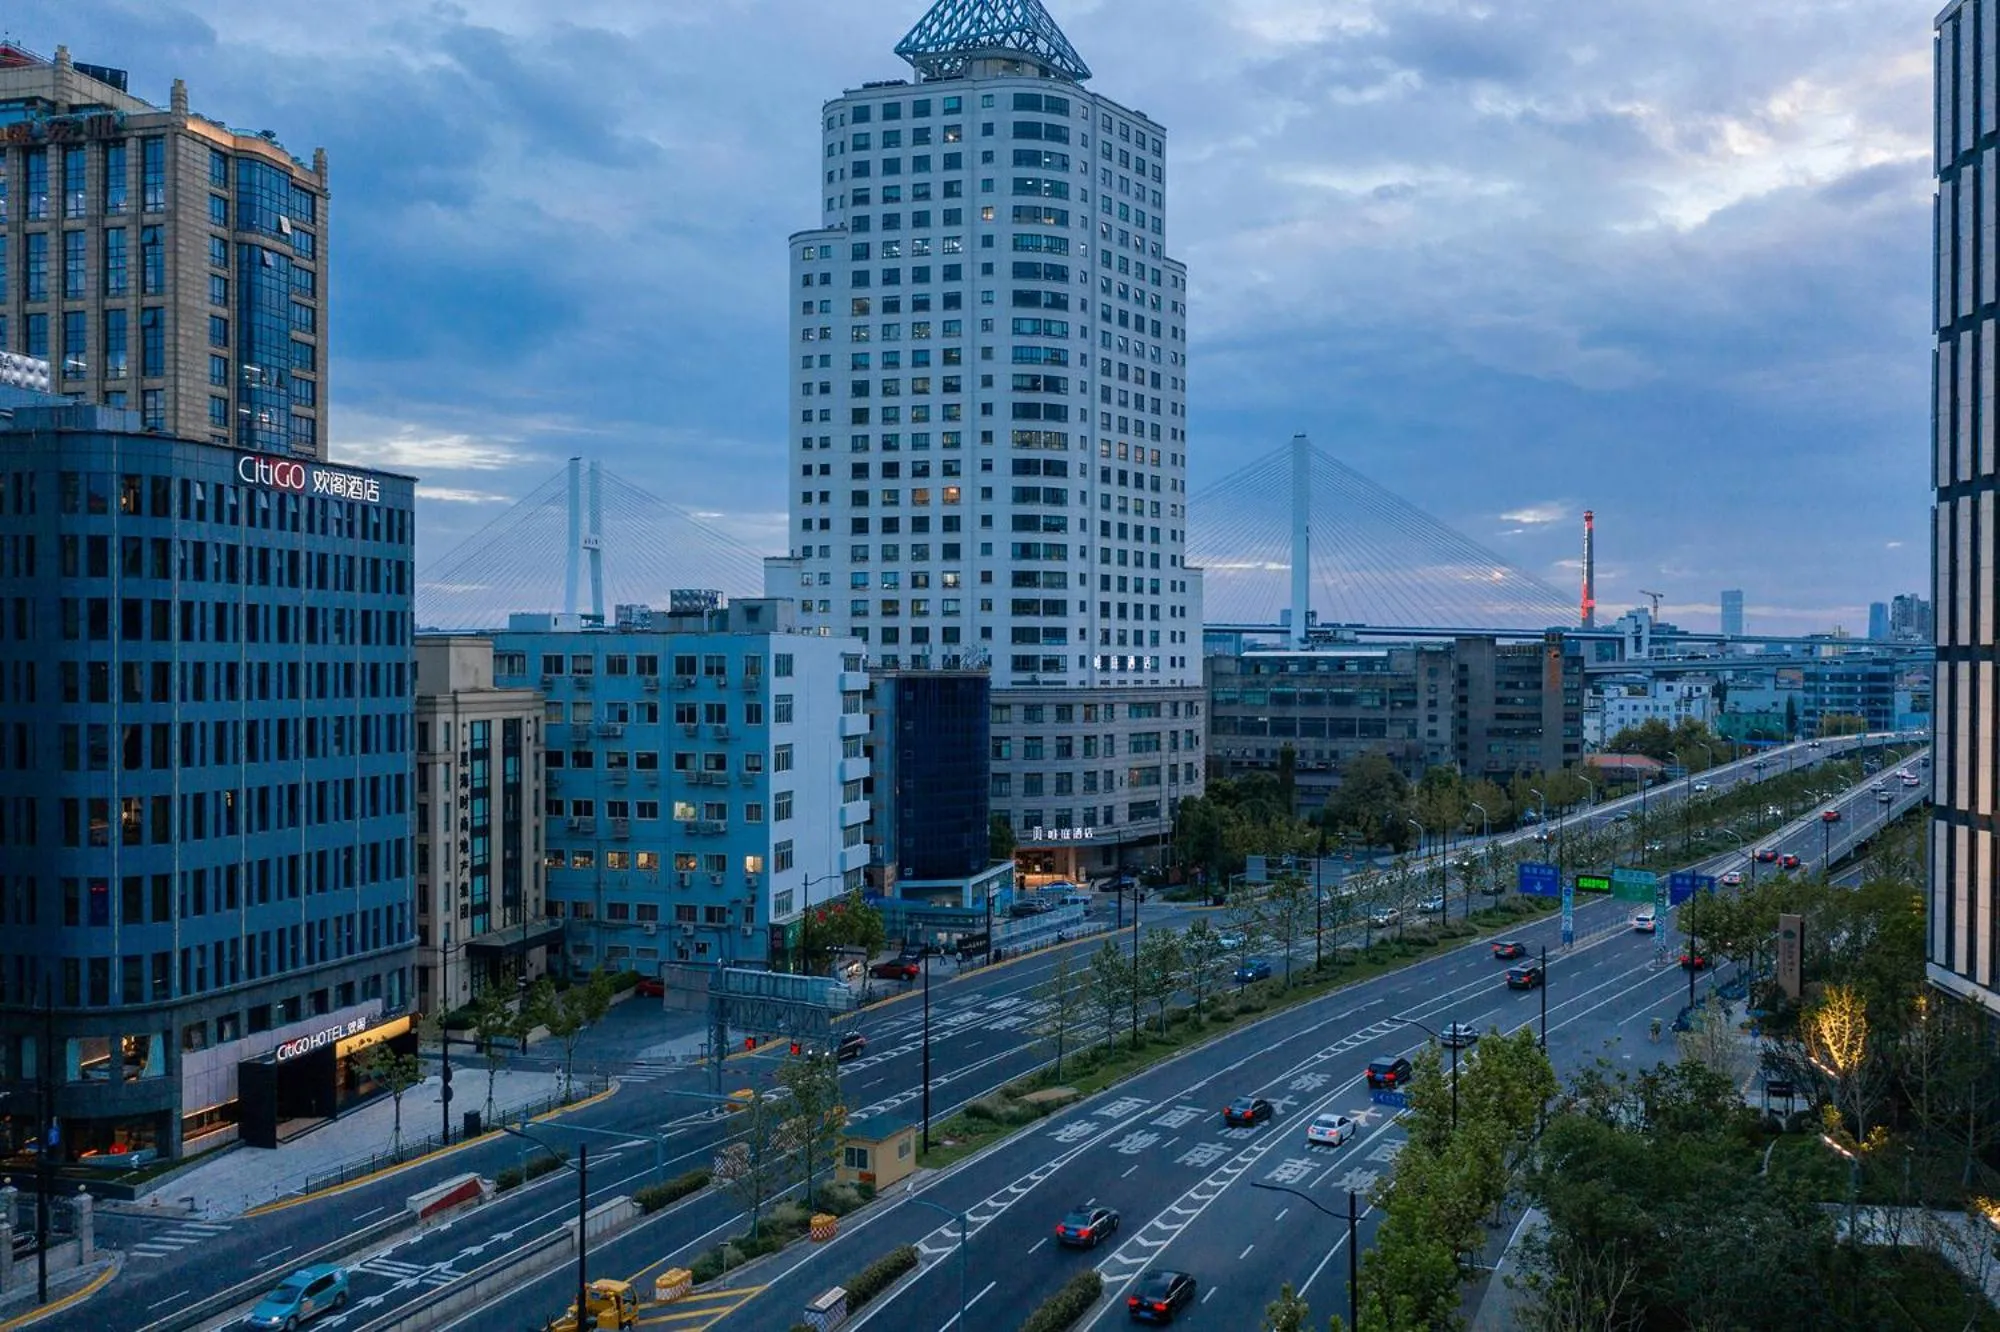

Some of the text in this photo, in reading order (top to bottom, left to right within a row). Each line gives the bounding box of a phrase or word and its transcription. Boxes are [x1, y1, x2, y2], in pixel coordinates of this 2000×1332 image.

[313, 469, 380, 503] 欢阁酒店
[311, 1025, 345, 1048] HOTEL
